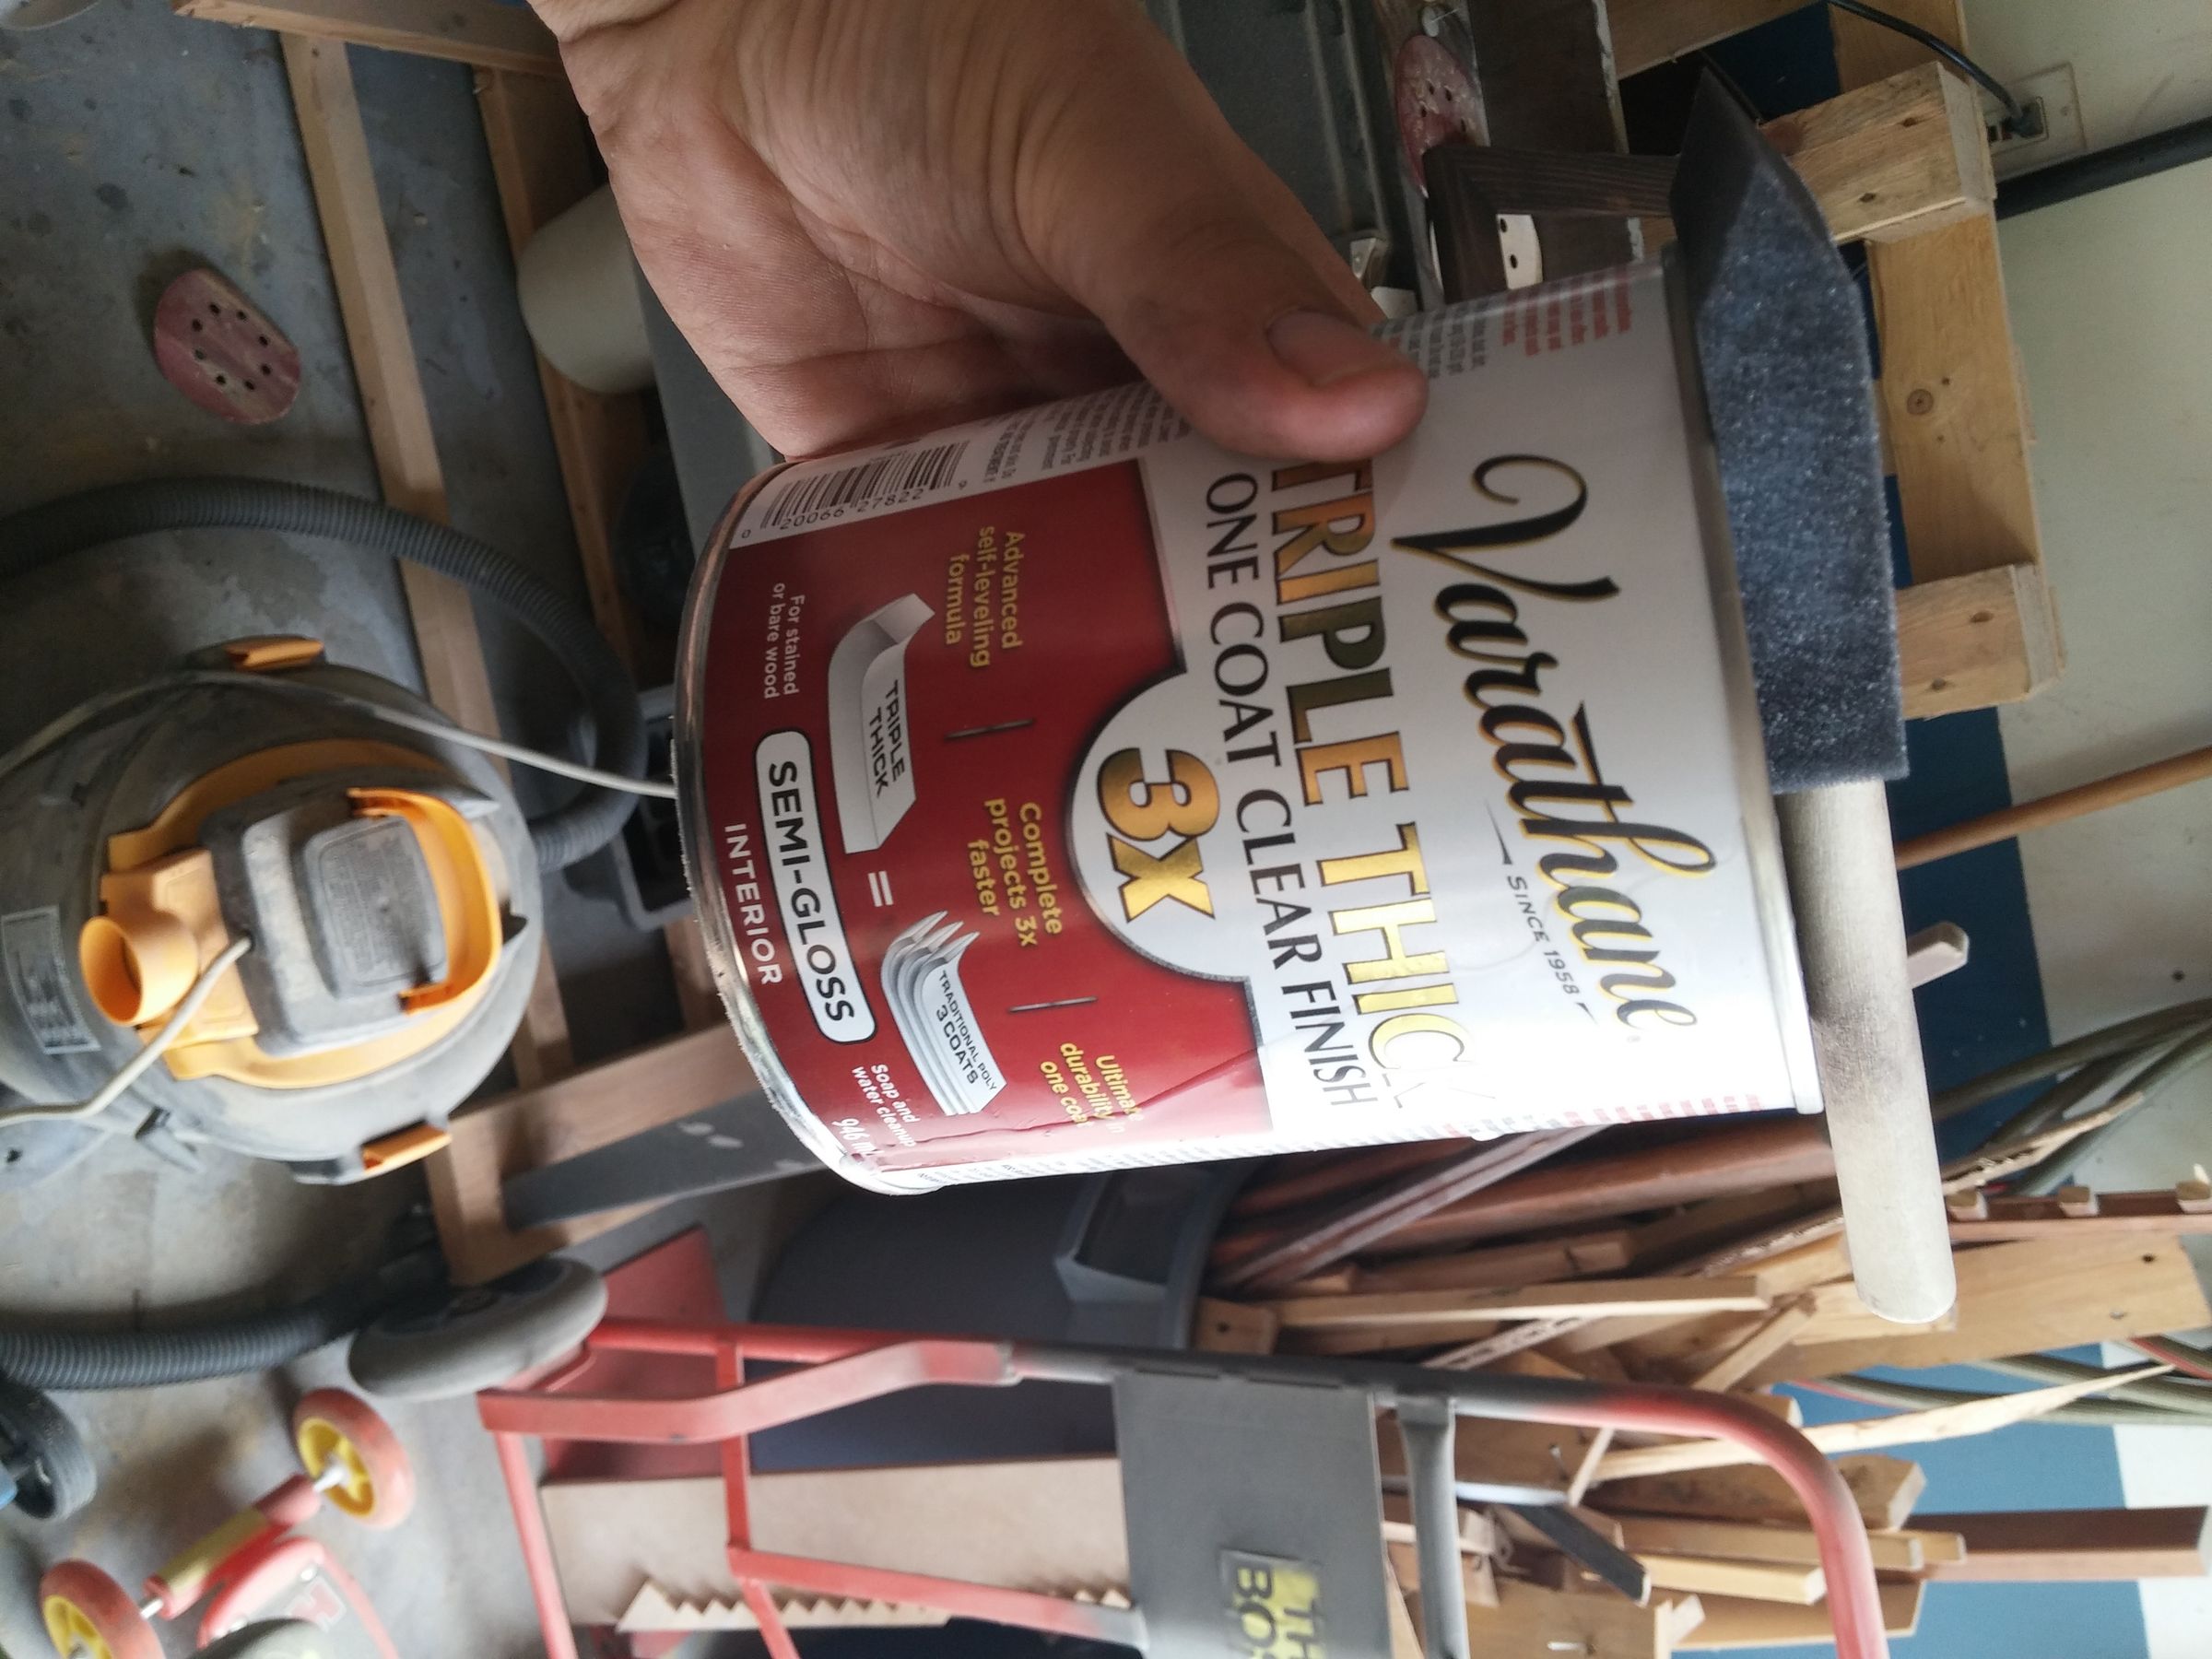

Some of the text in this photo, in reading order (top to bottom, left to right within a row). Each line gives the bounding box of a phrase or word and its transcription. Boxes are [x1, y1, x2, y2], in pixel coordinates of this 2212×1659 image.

[741, 529, 751, 539] 0
[779, 508, 845, 531] 20066
[856, 488, 924, 513] 27822
[764, 582, 785, 700] or bare wood
[946, 553, 971, 645] formula
[970, 526, 998, 667] self-leveling
[1001, 531, 1026, 649] Advanced
[1270, 461, 1409, 807] TRIPLE
[782, 594, 806, 695] For stained
[868, 706, 889, 799] THICK
[884, 679, 906, 782] TRIPLE
[1390, 453, 1716, 1030] Varathane
[1206, 472, 1379, 1106] ONE COAT CLEAR FINISH
[724, 823, 783, 985] INTERIOR
[768, 760, 855, 1021] SEMI-GLOSS
[968, 839, 1001, 916] faster
[983, 798, 1038, 947] projects 3x
[1018, 802, 1063, 935] Complete
[1507, 875, 1580, 995] SINCE 1958
[935, 1005, 980, 1085] 3 COATS
[938, 970, 998, 1092] TRADITIONAL POLY
[1060, 1042, 1116, 1120] durability
[831, 1117, 871, 1141] 946
[851, 1065, 917, 1147] water cleanup
[870, 1063, 921, 1124] Soap and
[1040, 1061, 1095, 1128] one coat
[1095, 1054, 1145, 1122] Ultimate
[1233, 1564, 1277, 1659] BO
